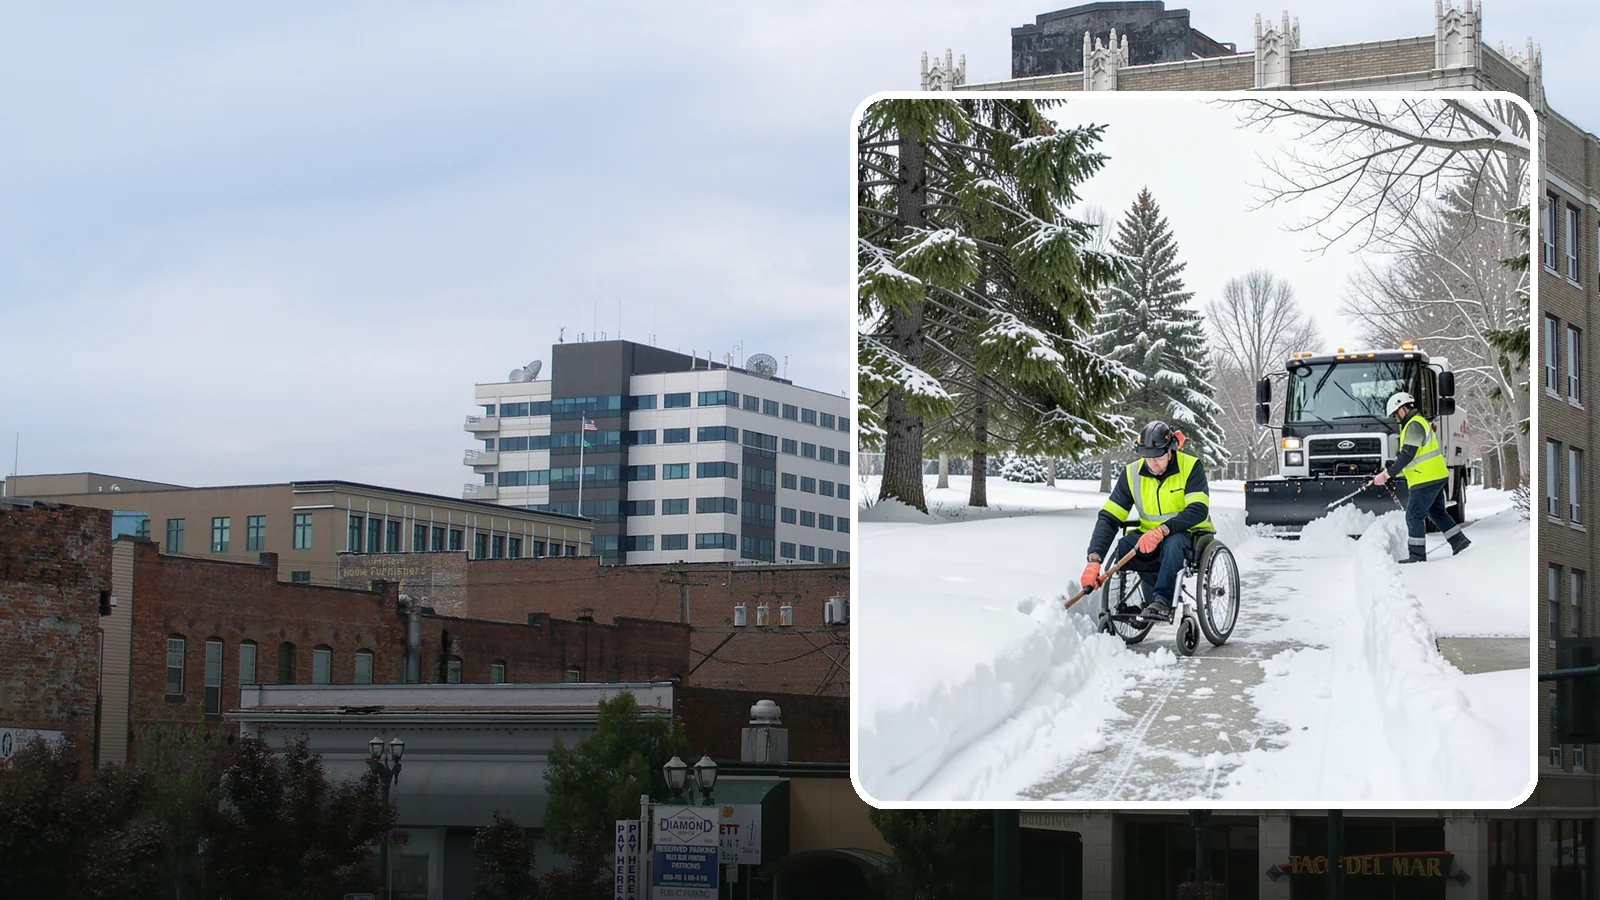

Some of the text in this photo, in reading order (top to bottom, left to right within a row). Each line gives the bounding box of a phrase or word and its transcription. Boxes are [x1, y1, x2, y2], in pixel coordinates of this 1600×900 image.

[343, 566, 427, 577] Home Furnishers
[660, 818, 713, 832] DIAMOND
[1021, 815, 1070, 828] BUILDING
[617, 825, 625, 852] PAY
[628, 825, 637, 852] PAY
[656, 845, 716, 854] RESERVED PARKING
[722, 852, 739, 861] Soup
[671, 862, 701, 870] PATRONS
[1346, 856, 1384, 876] DEL
[1392, 857, 1442, 877] MAR
[616, 856, 625, 894] HERE
[627, 856, 636, 893] HERE
[660, 889, 710, 898] PUBLIC PARKING
